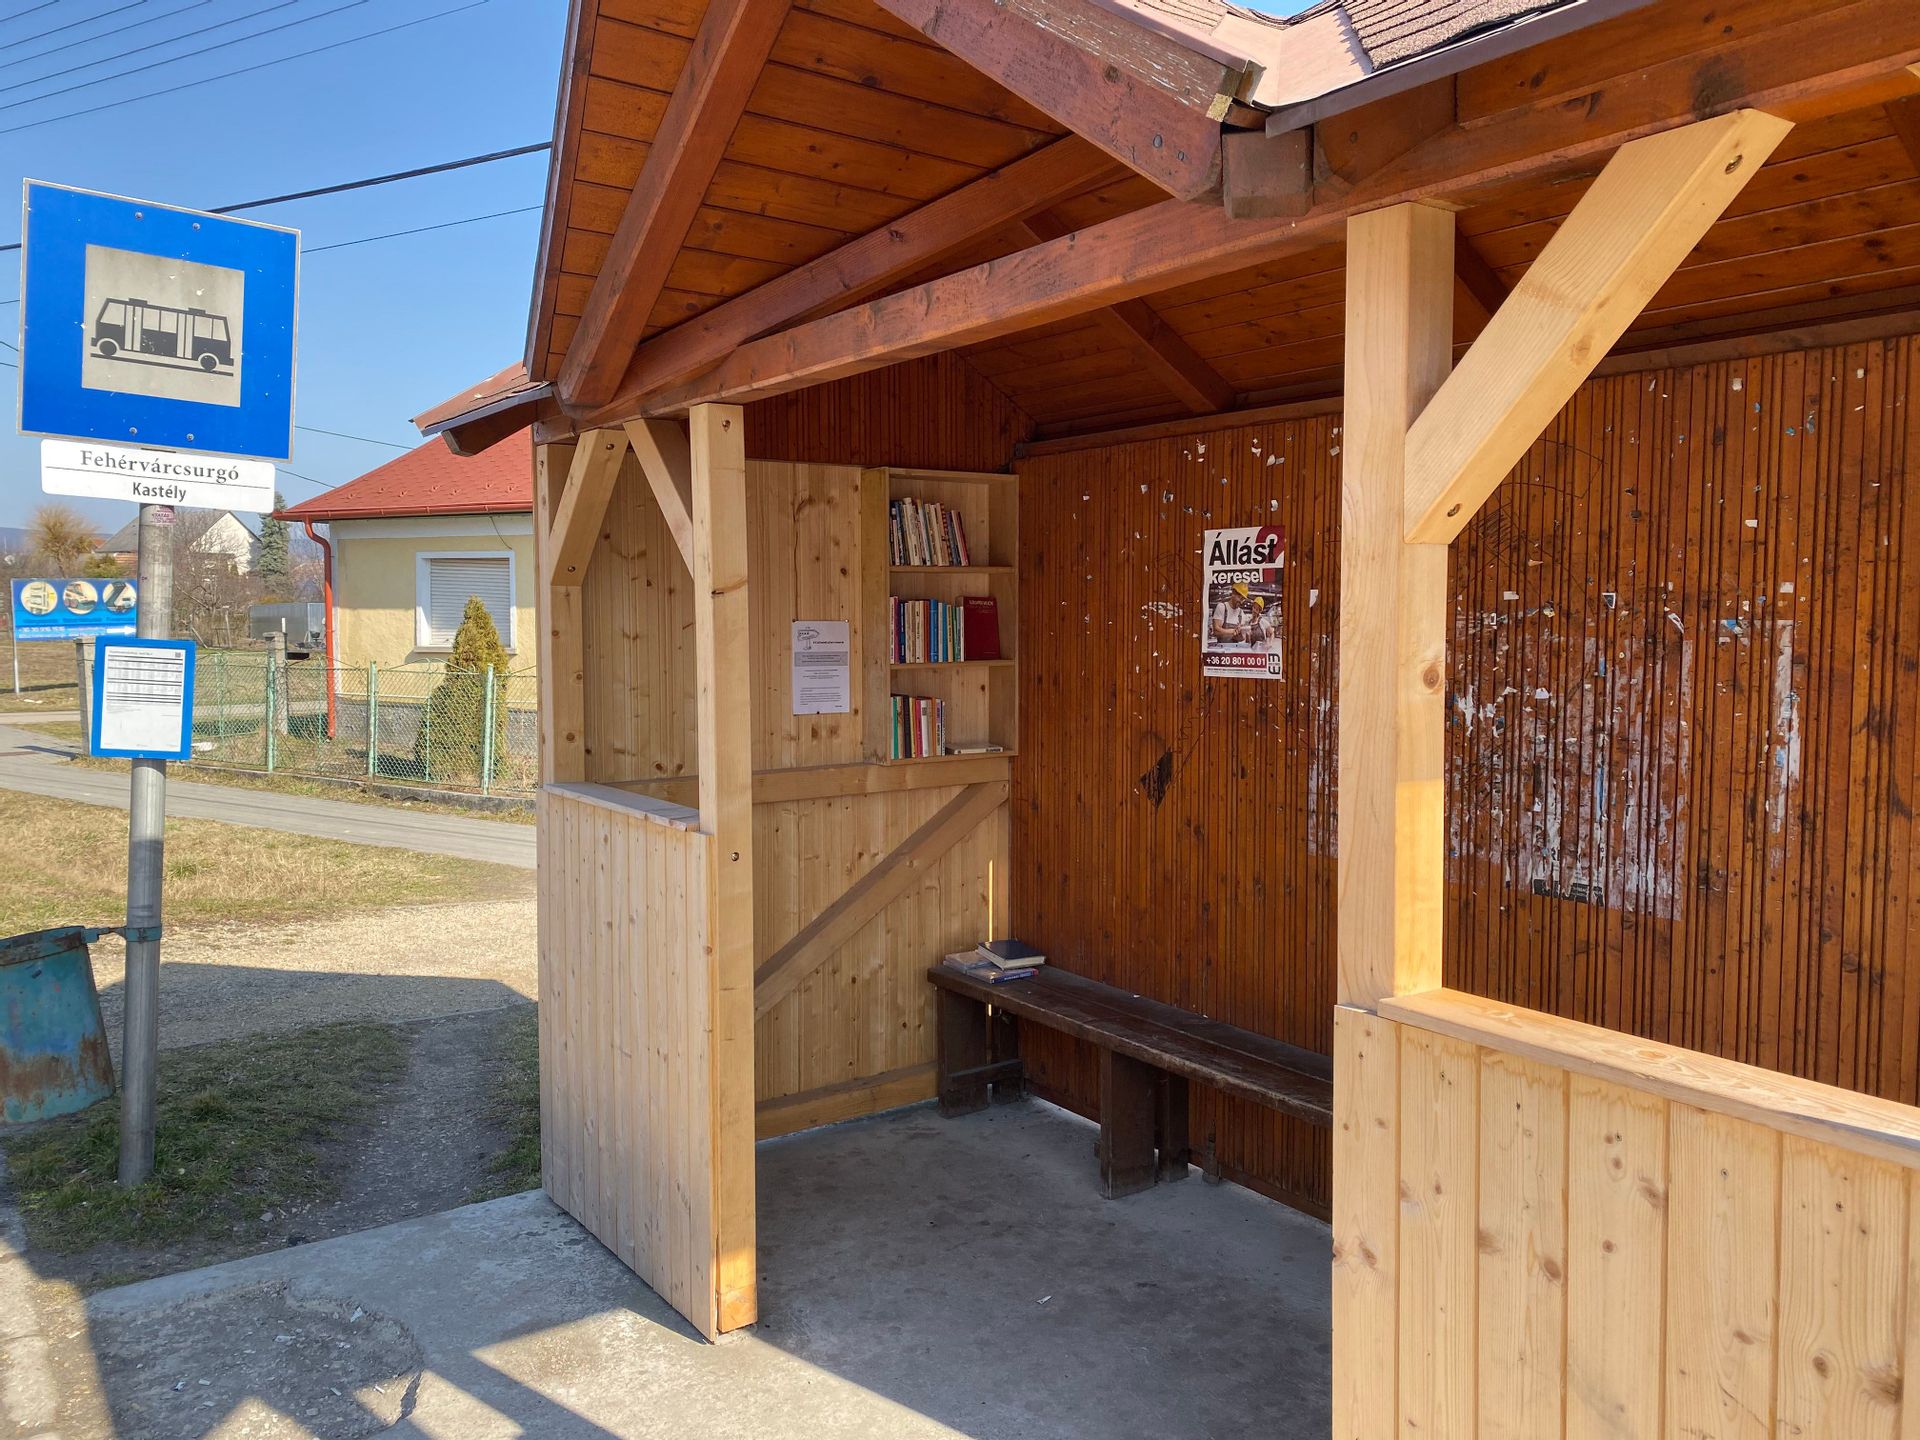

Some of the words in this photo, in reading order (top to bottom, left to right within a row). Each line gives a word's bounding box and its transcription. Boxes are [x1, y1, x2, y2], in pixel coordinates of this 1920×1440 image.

[80, 450, 239, 483] Fehérvárcsurgó
[132, 481, 187, 502] Kastély
[1208, 532, 1276, 566] Állást
[1210, 568, 1264, 584] keresel
[1206, 656, 1220, 665] +36
[1220, 656, 1231, 665] 20
[1232, 656, 1246, 665] 801
